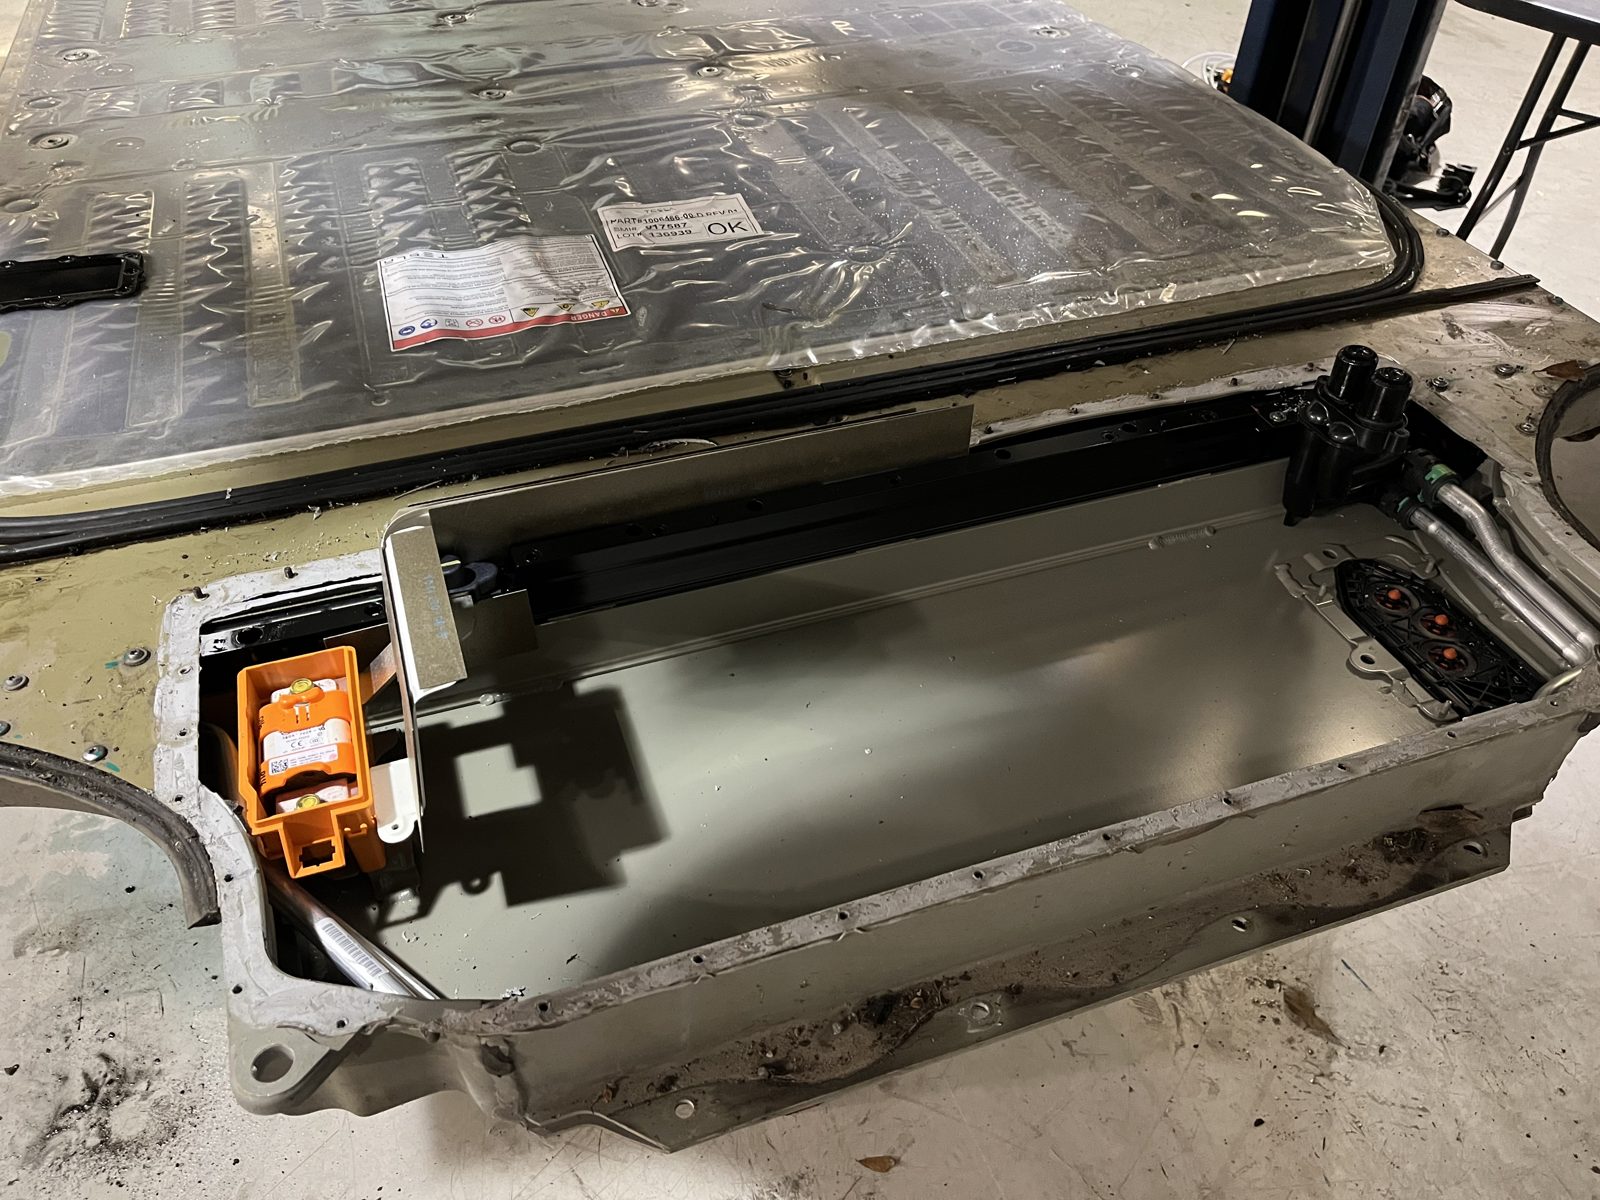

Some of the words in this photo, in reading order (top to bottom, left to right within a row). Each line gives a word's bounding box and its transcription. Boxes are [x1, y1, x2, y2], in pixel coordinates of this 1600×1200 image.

[649, 229, 692, 238] 136939
[707, 221, 749, 235] OK
[570, 310, 608, 321] DANGER
